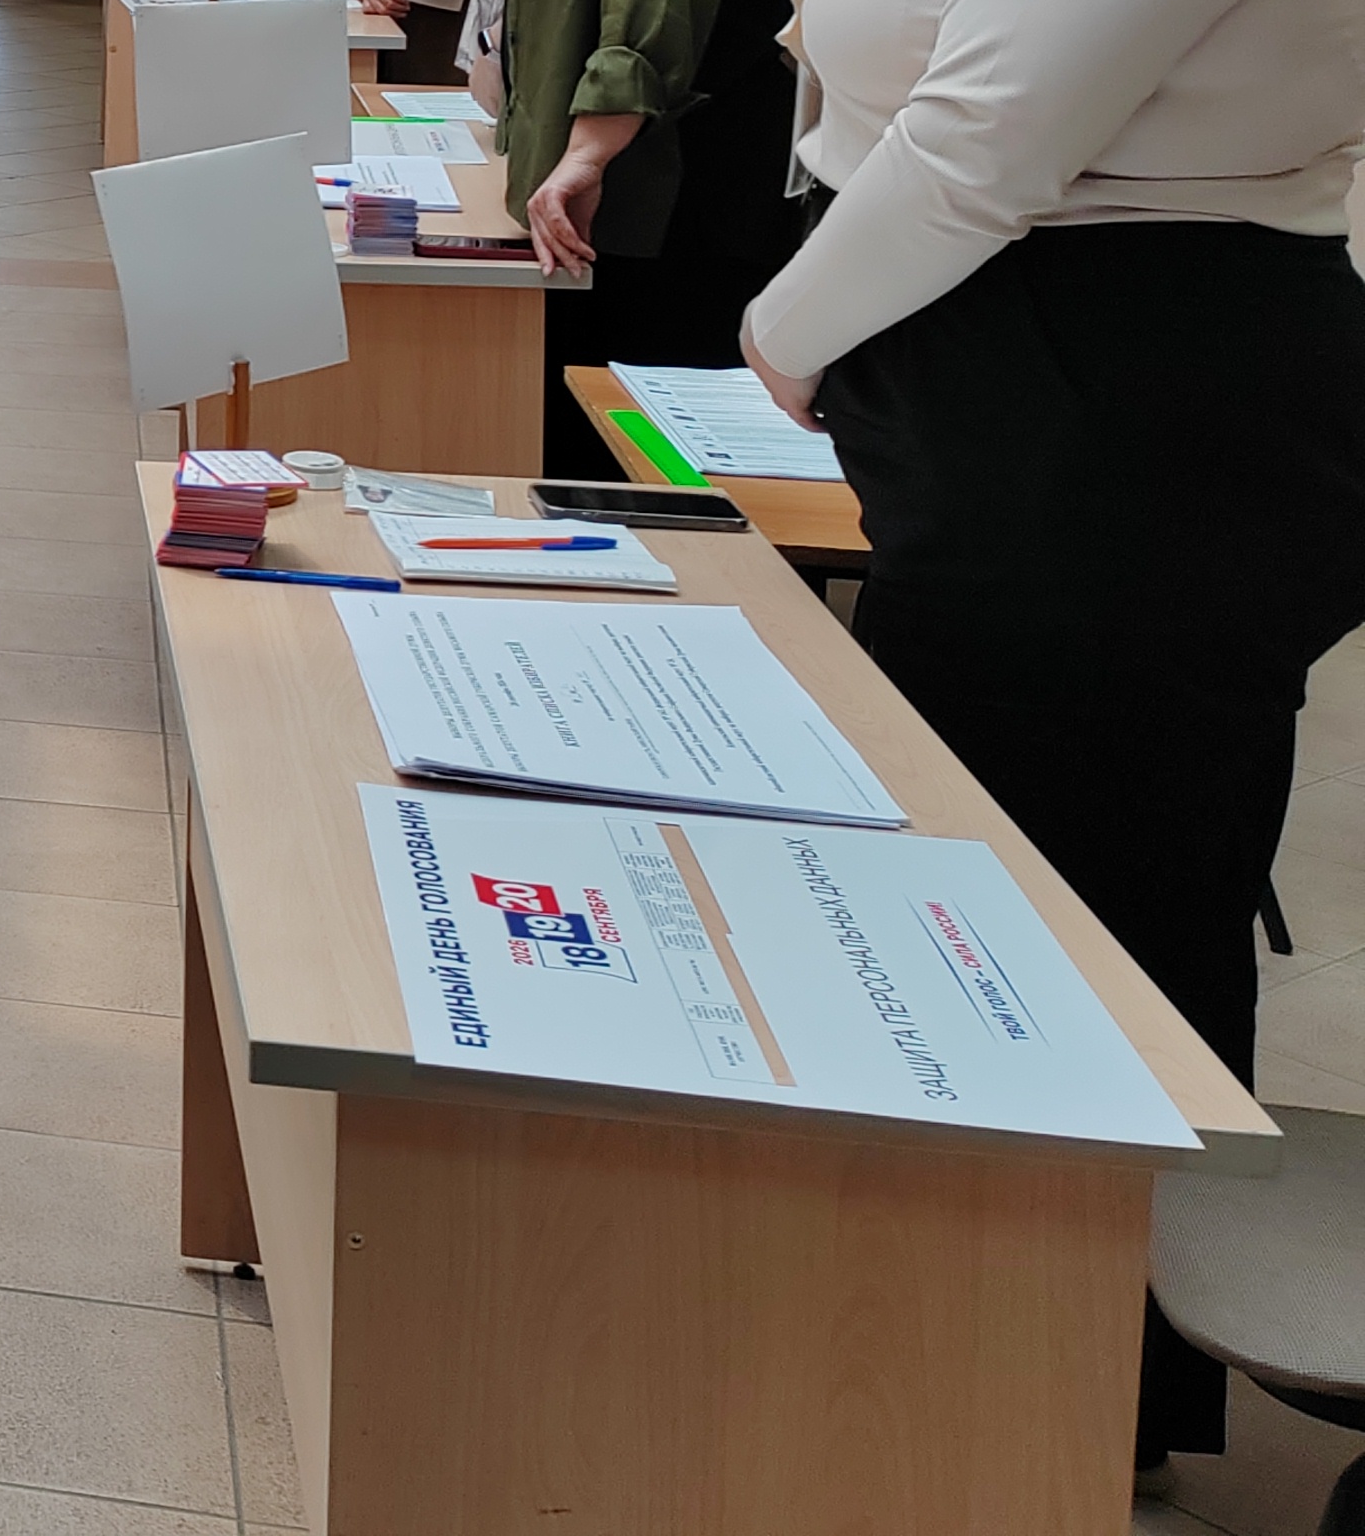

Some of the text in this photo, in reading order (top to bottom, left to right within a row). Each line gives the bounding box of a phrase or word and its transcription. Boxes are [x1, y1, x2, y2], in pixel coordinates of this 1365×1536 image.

[553, 721, 580, 747] КНИГА
[396, 800, 452, 914] ГОЛОСОВАНИЯ
[782, 837, 846, 897] ДАННЫХ
[493, 884, 542, 911] 20
[583, 888, 621, 942] СЕНТЯБРЯ
[526, 916, 574, 937] 19
[925, 902, 965, 941] РОССИИ!
[425, 918, 471, 964] ДЕНЬ
[508, 940, 534, 966] 2026
[561, 946, 611, 967] 18
[952, 943, 982, 968] СИЛА
[814, 897, 915, 1025] ПЕРСОНАЛЬНЫХ
[428, 965, 491, 1048] ЕДИНЫЙ
[974, 979, 1011, 1011] ГОЛОС
[992, 1013, 1029, 1040] ТВОЙ
[890, 1030, 958, 1101] ЗАЩИТА
